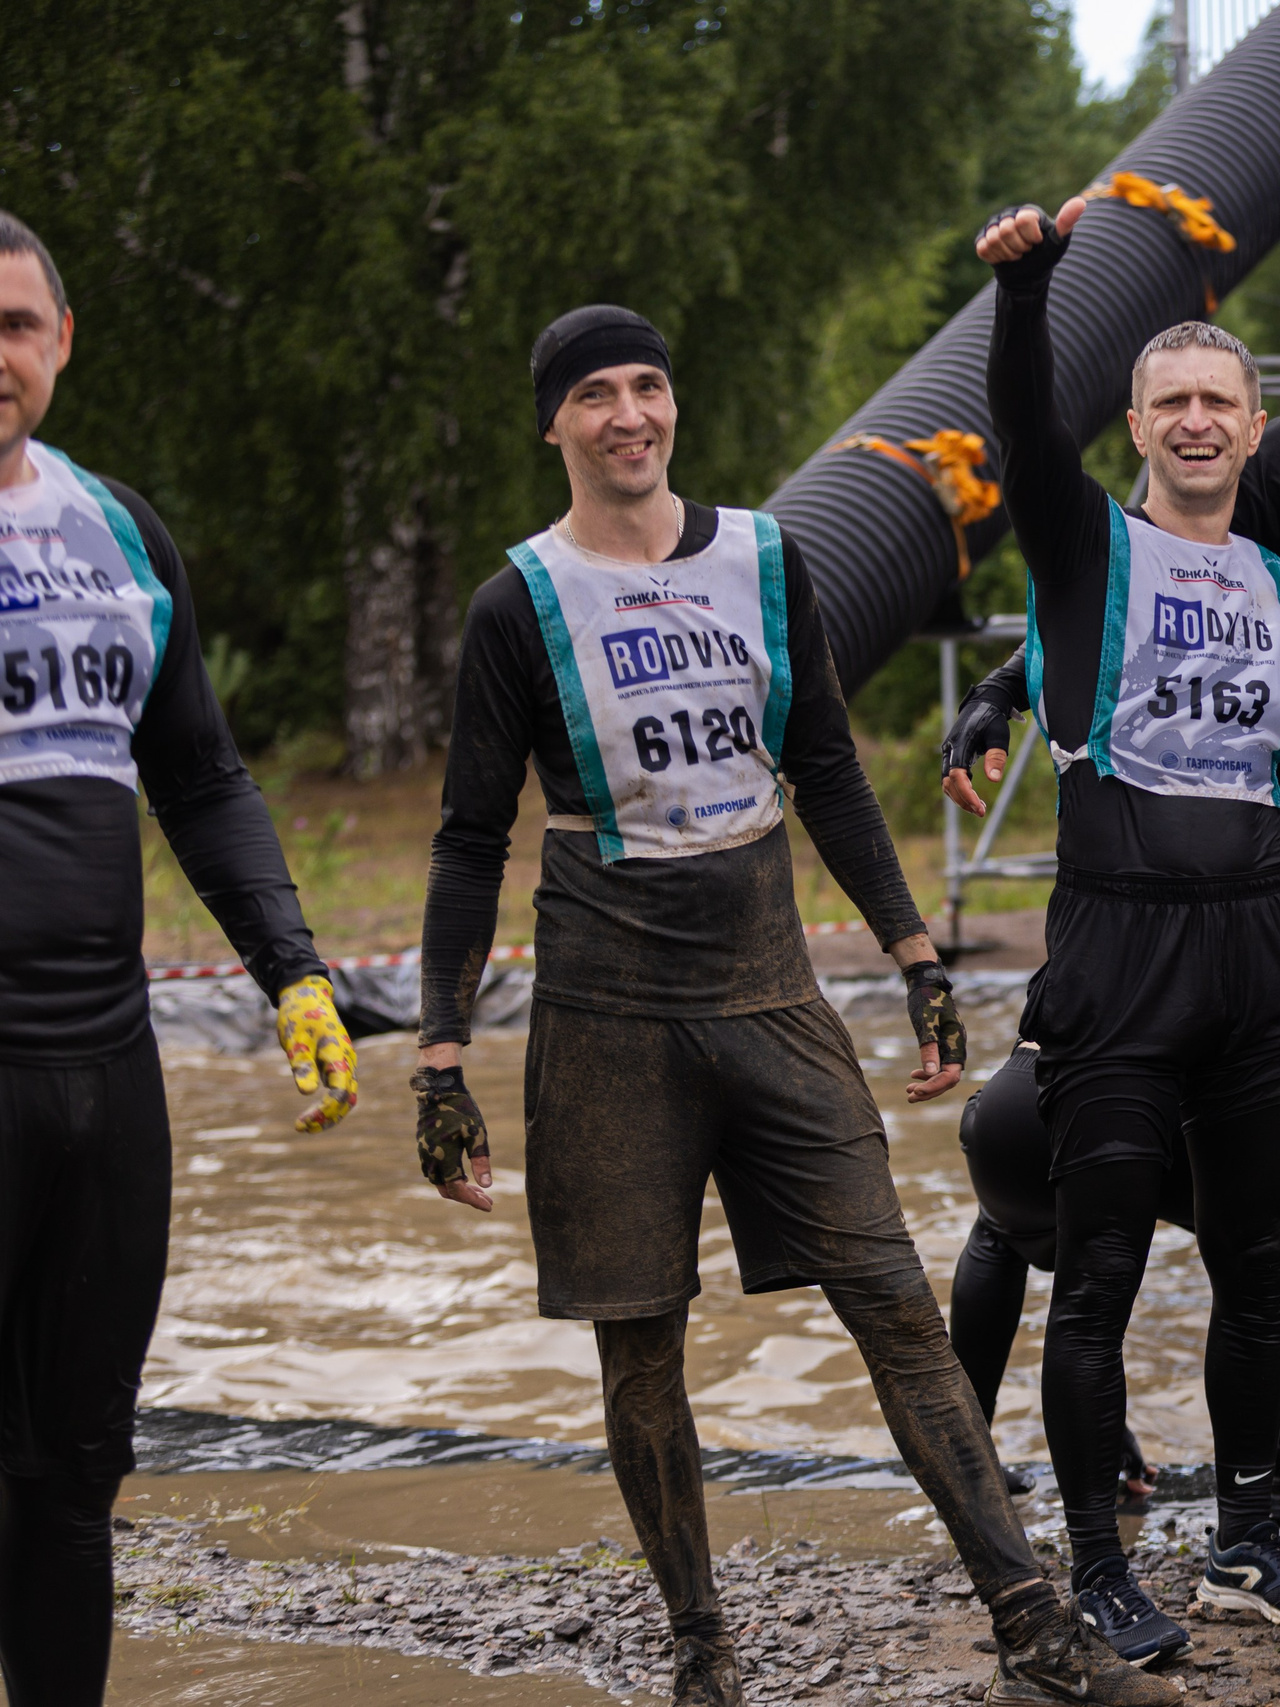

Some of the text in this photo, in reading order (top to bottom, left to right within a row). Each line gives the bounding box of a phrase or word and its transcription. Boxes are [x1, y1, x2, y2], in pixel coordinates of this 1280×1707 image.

[614, 590, 710, 607] ГОНКА ГЕРОЕВ
[1170, 568, 1245, 588] ГОНКА ГЕРОЕВ
[1159, 601, 1273, 652] RODVIG
[3, 643, 134, 716] 5160
[608, 630, 749, 681] RODVIG
[1147, 674, 1270, 728] 5163
[632, 706, 757, 773] 6120
[1186, 757, 1253, 772] ГАЗПРОМБАНК
[694, 796, 758, 819] ГАЗПРОМБАНК
